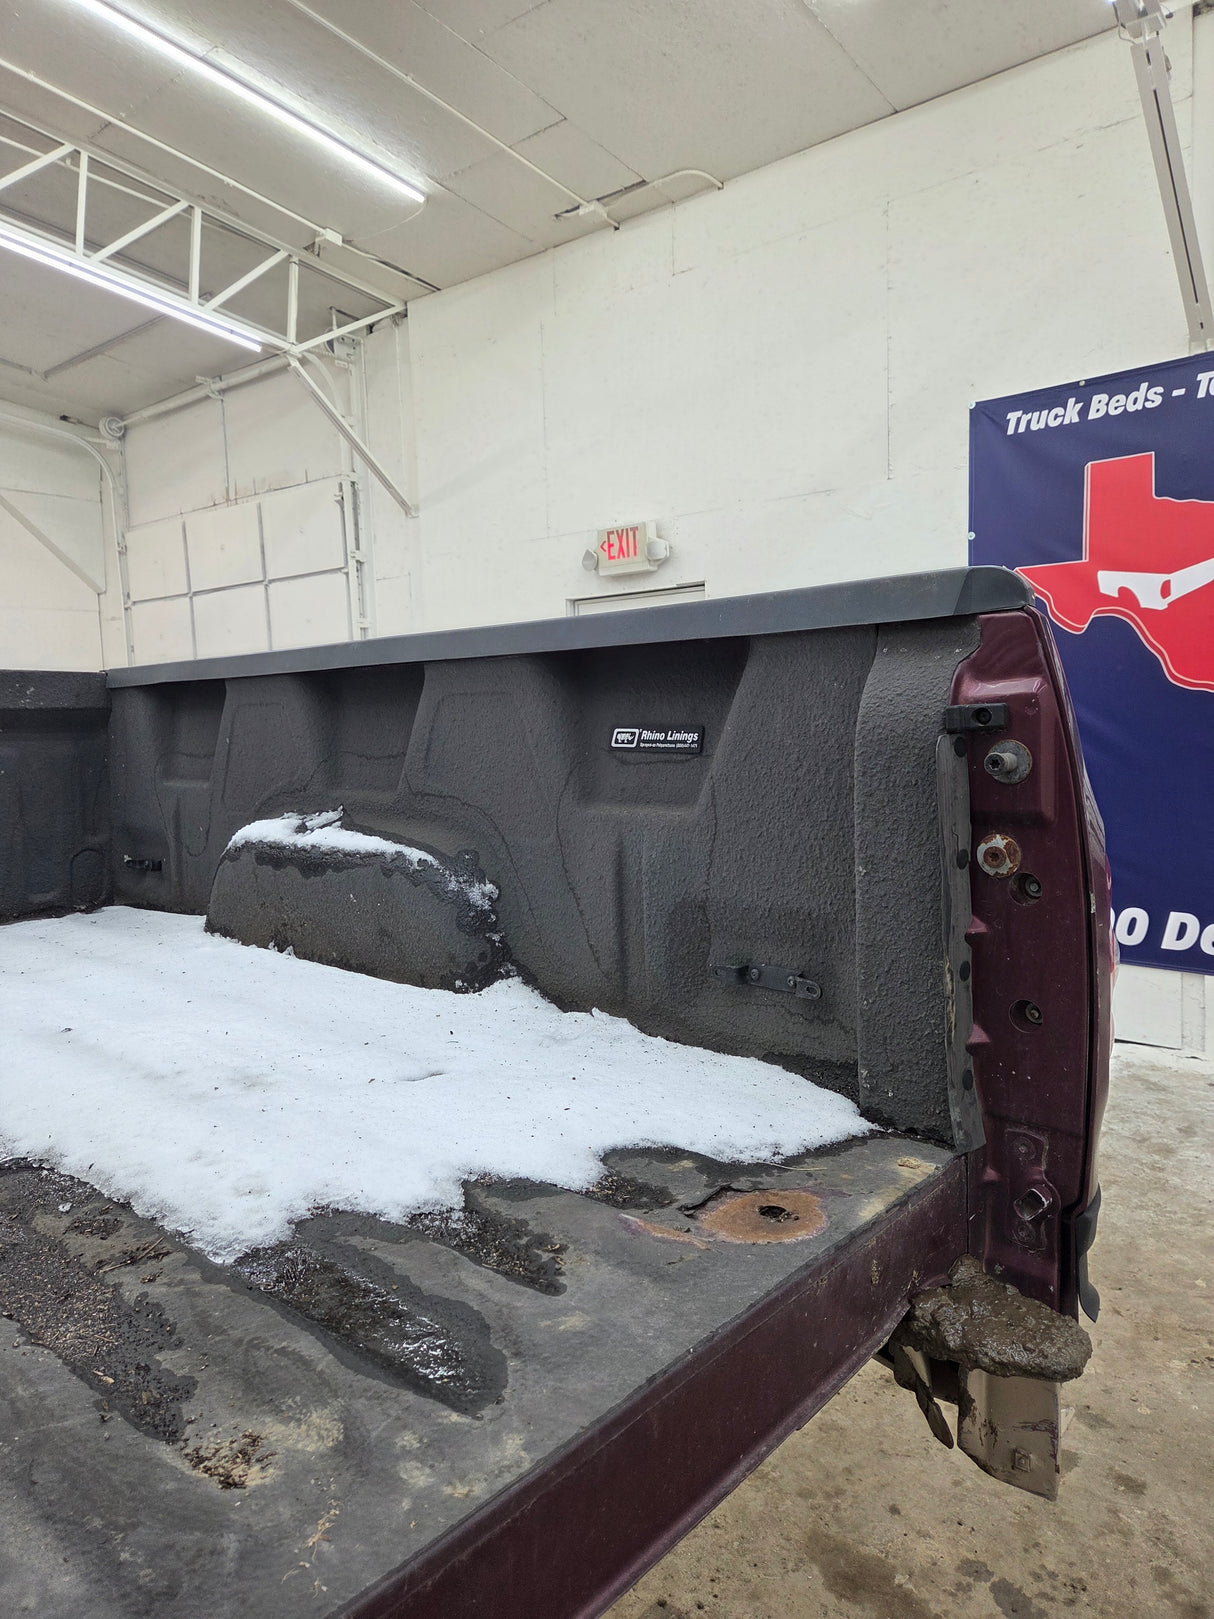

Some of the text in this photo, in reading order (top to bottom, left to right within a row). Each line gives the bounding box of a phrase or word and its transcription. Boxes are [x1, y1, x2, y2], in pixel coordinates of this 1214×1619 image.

[1006, 397, 1084, 435] Truck
[1088, 382, 1164, 420] Beds
[606, 526, 638, 560] EXIT
[641, 730, 698, 743] Rhino Linings
